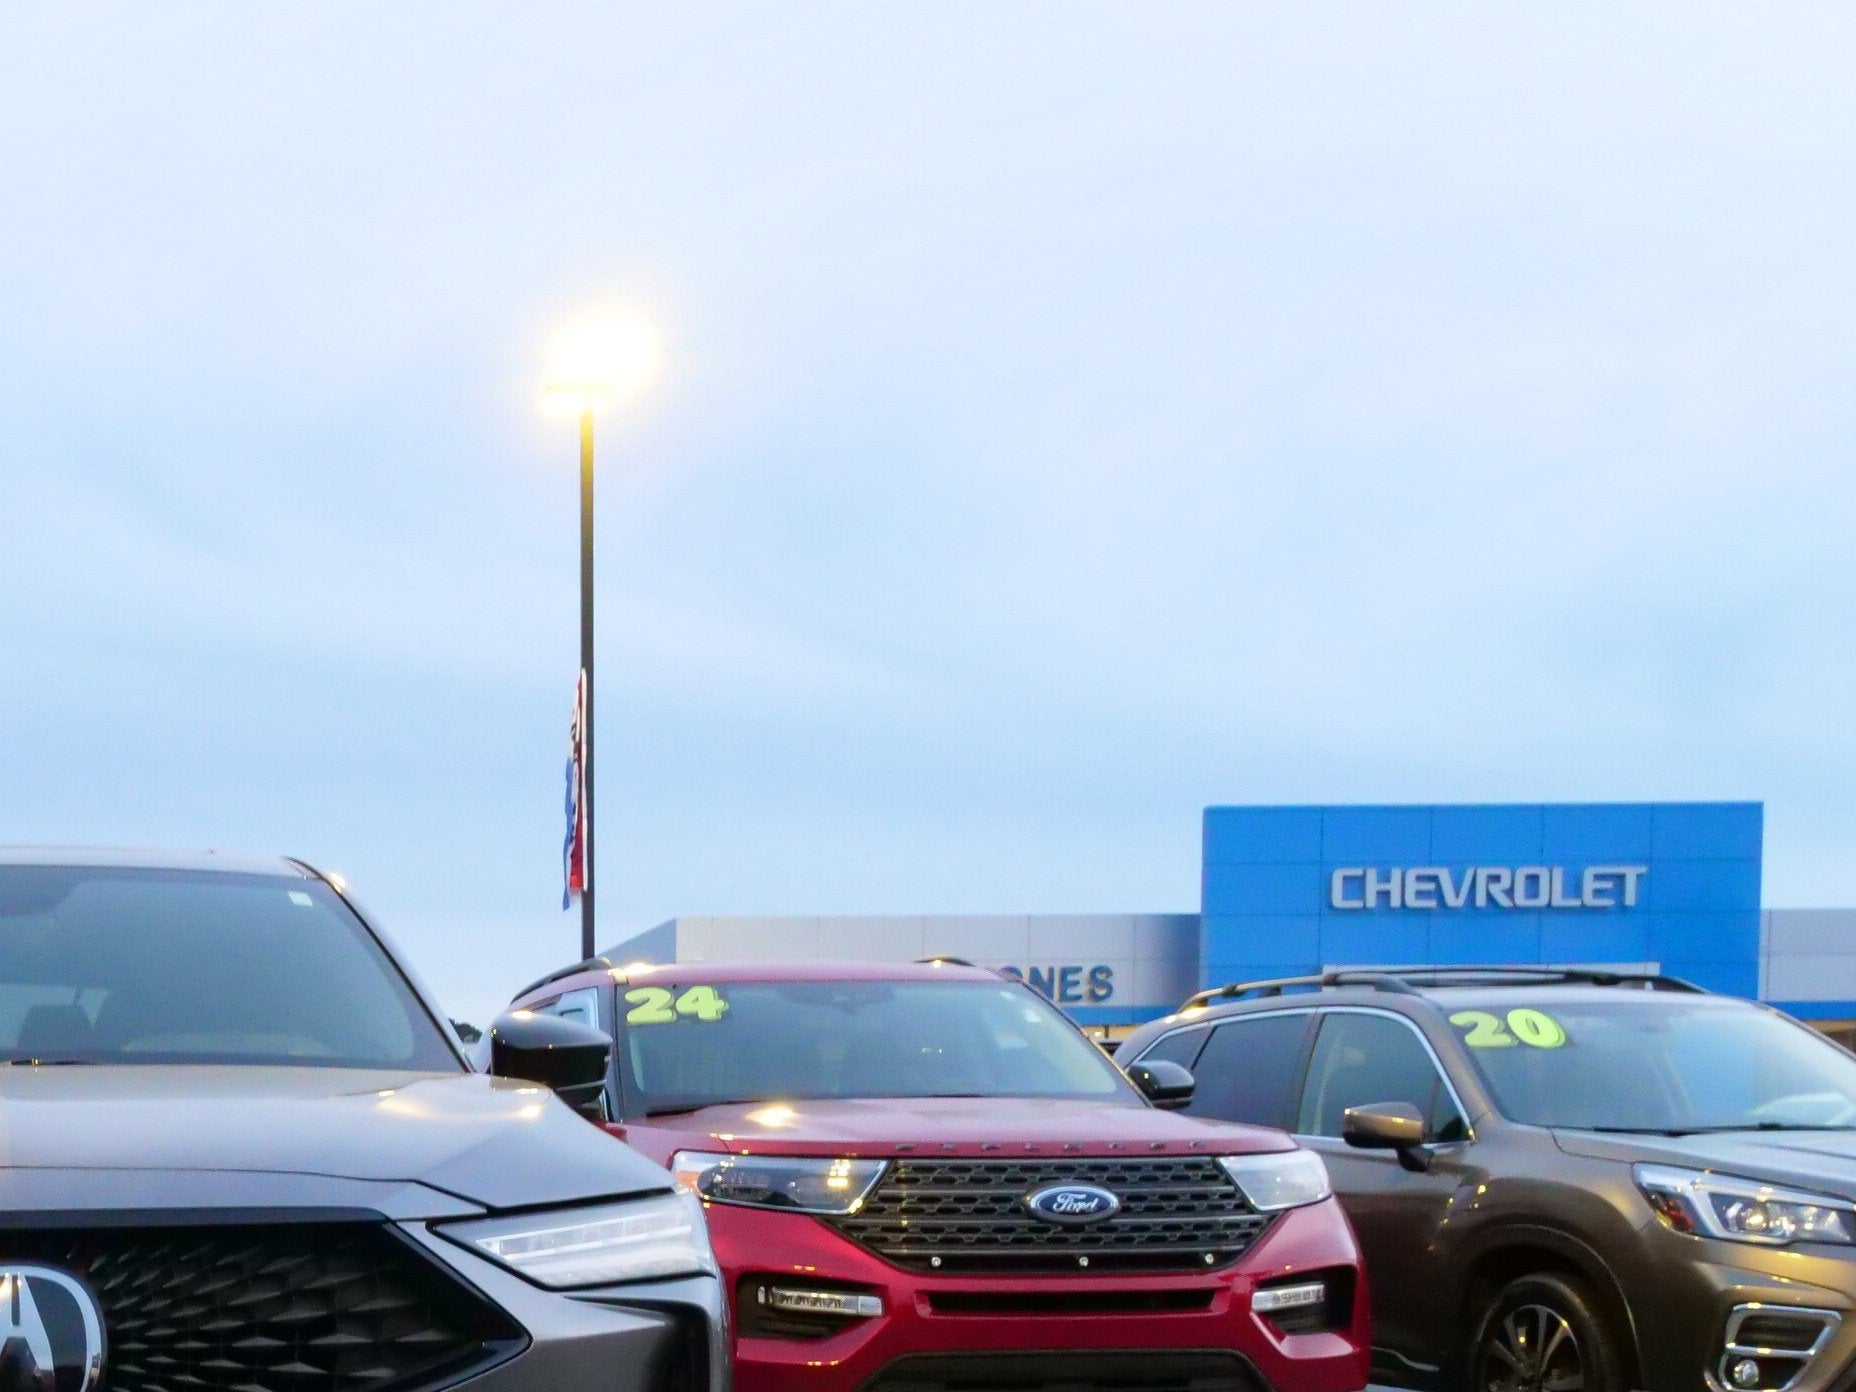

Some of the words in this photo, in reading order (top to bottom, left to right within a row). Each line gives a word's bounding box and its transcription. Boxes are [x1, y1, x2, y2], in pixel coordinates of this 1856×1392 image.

[1331, 866, 1648, 908] CHEVROLET
[624, 985, 730, 1026] 24
[1448, 1008, 1566, 1048] 20
[1052, 1192, 1099, 1213] Ford
